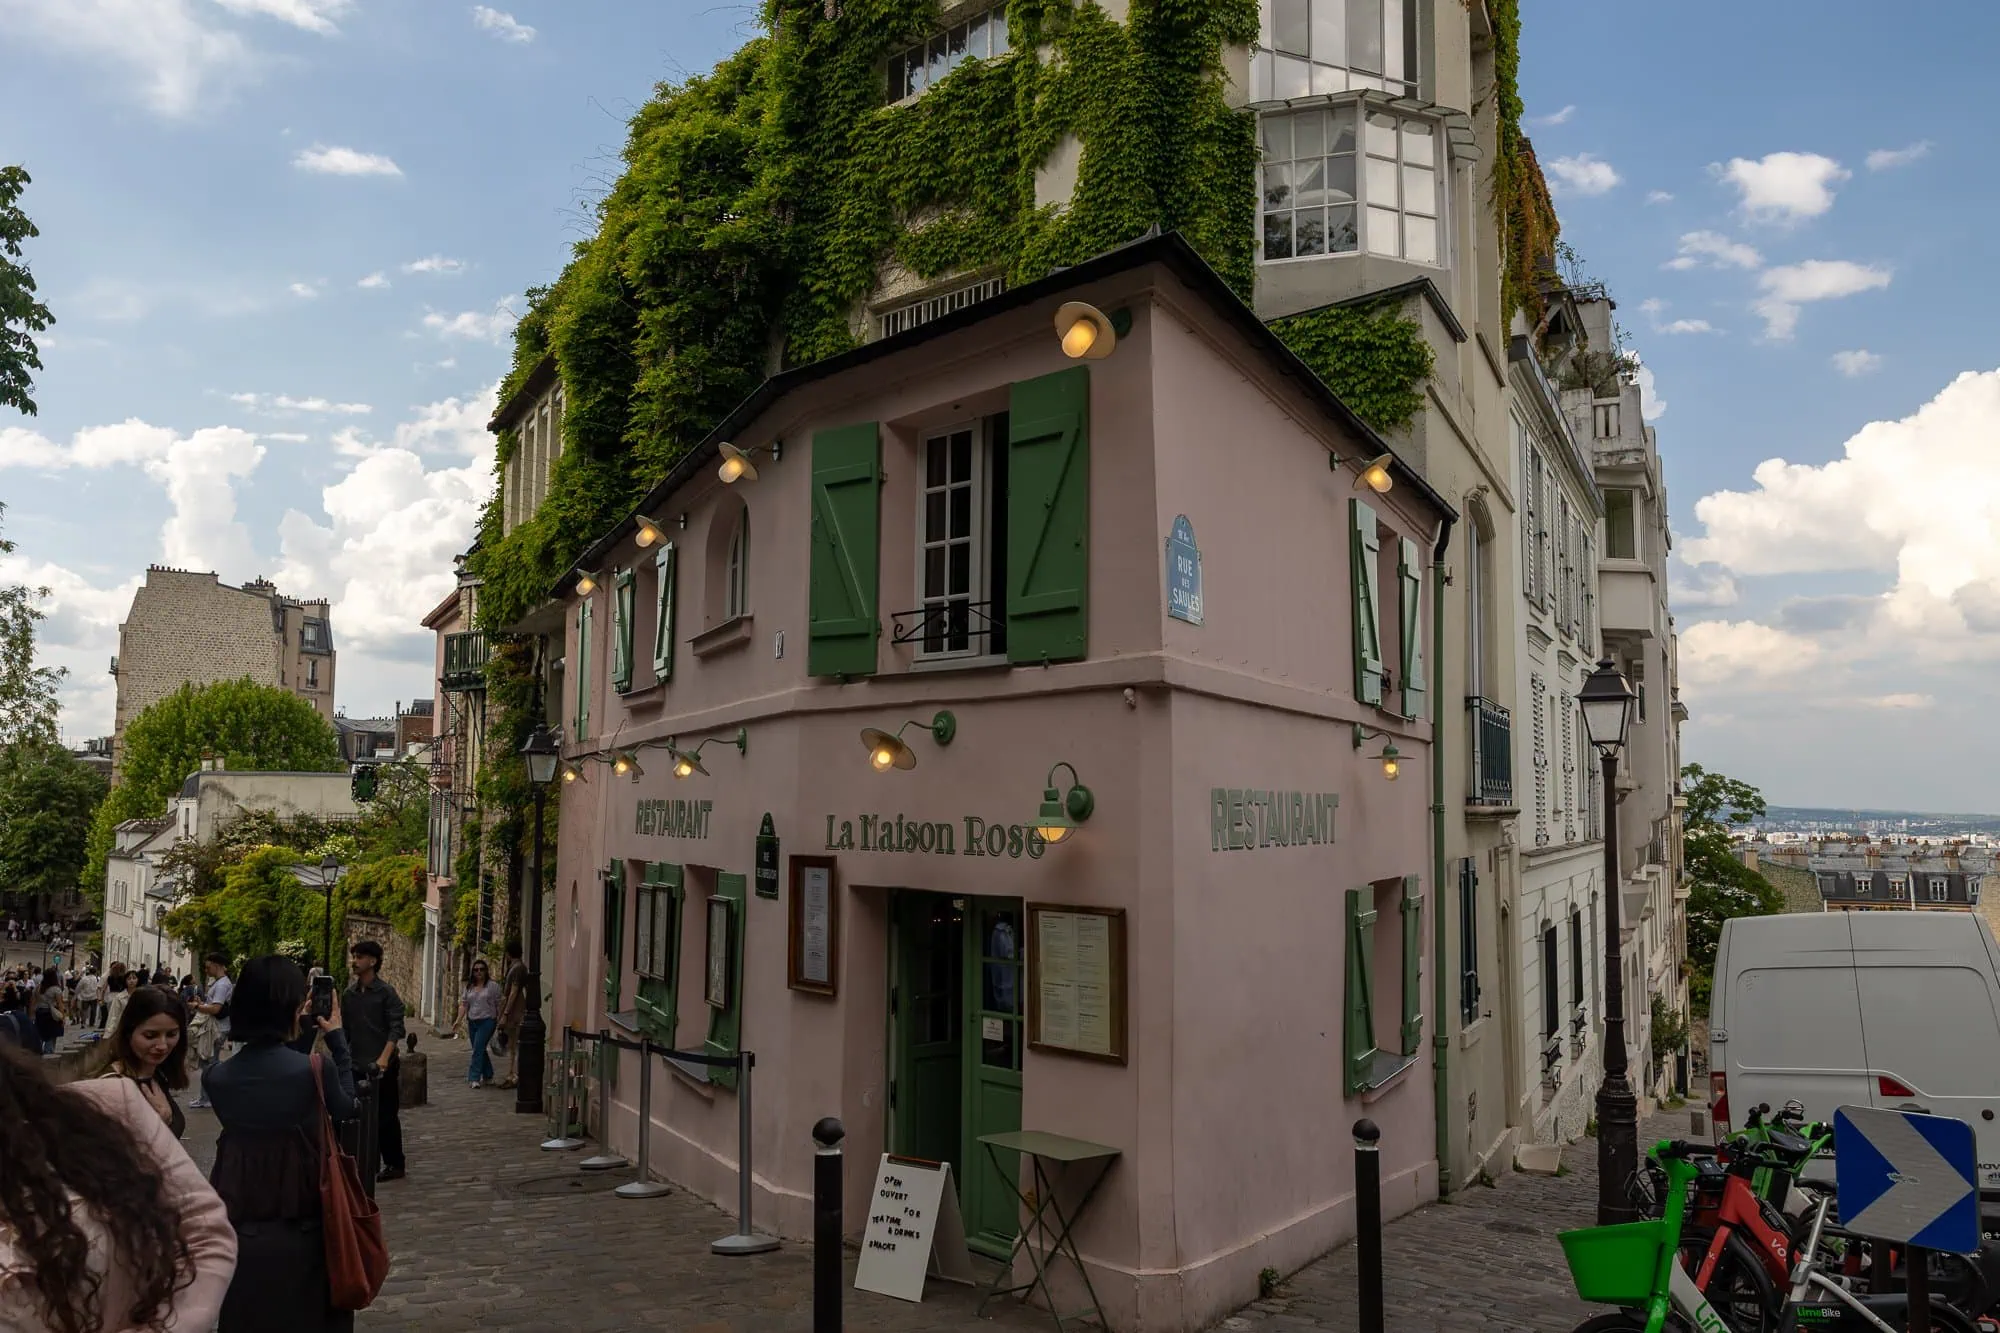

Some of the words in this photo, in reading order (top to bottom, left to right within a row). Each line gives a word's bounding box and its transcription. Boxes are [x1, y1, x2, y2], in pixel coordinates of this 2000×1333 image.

[1177, 554, 1193, 577] RUE
[1172, 587, 1200, 613] SAULES
[635, 799, 713, 839] RESTAURANT
[1210, 787, 1339, 852] RESTAURANT
[824, 814, 855, 851] La
[858, 812, 956, 856] Maison
[963, 815, 1046, 860] Rose
[884, 1176, 902, 1187] OPEN
[880, 1189, 908, 1201] OUVERT
[904, 1207, 921, 1218] FOR
[894, 1228, 920, 1240] DRINKS
[869, 1240, 896, 1251] SNACKS
[1796, 1306, 1841, 1318] LimeBike
